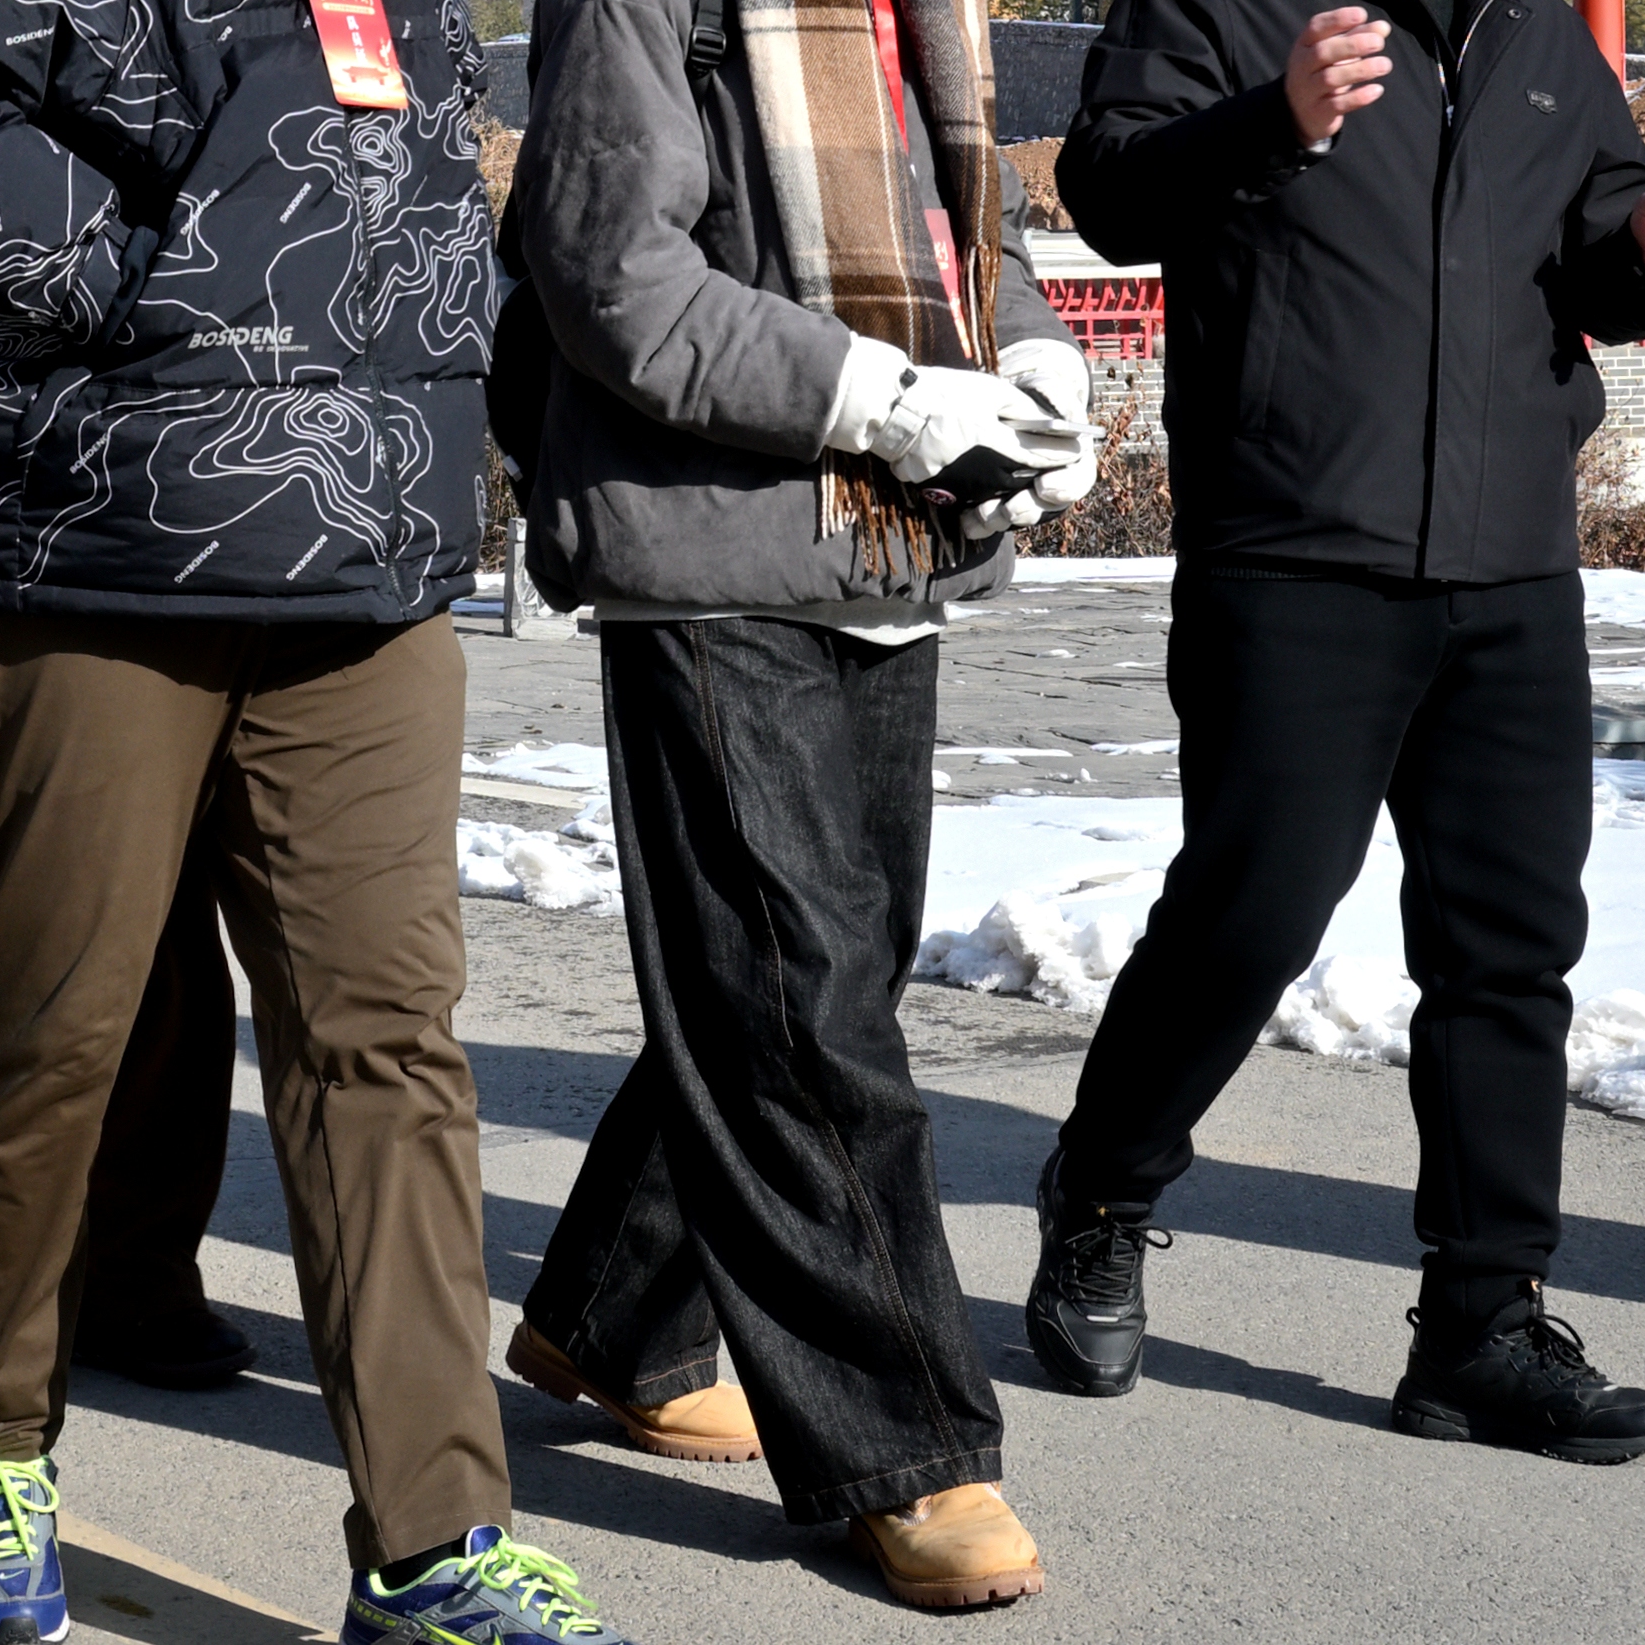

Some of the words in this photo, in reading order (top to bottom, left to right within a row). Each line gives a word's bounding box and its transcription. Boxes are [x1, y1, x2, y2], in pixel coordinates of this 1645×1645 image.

[5, 25, 55, 46] BOSIDEN
[279, 182, 312, 224] BOSIDENG
[188, 326, 294, 349] BOSIDENG
[69, 433, 110, 475] BOSIDENG
[174, 540, 220, 584] BOSIDENG
[286, 534, 329, 582] BOSIDENG
